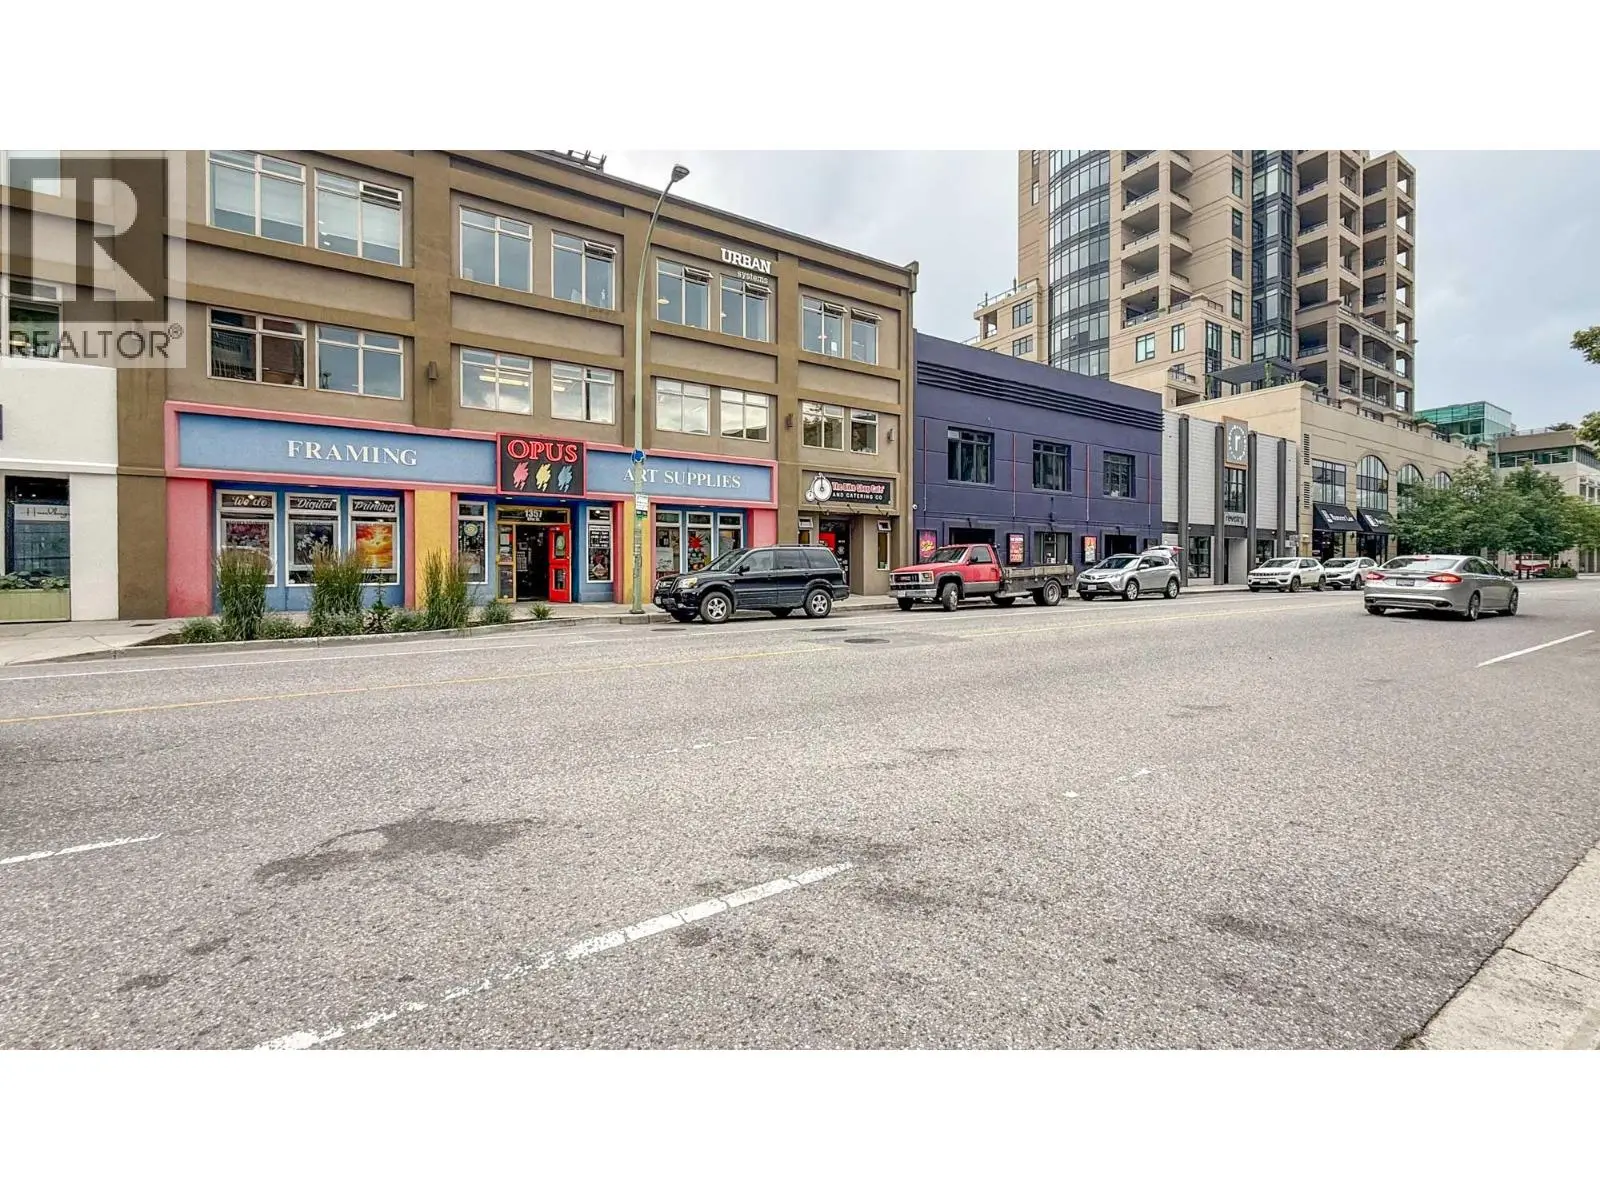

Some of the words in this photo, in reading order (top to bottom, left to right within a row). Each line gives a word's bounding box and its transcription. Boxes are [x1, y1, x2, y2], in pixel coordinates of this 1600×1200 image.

[720, 247, 771, 274] URBAN
[737, 271, 769, 284] systems
[287, 440, 417, 466] FRAMING
[507, 439, 578, 463] OPUS
[664, 470, 741, 489] SUPPLIES
[297, 498, 332, 510] Digital
[353, 501, 394, 512] Printing
